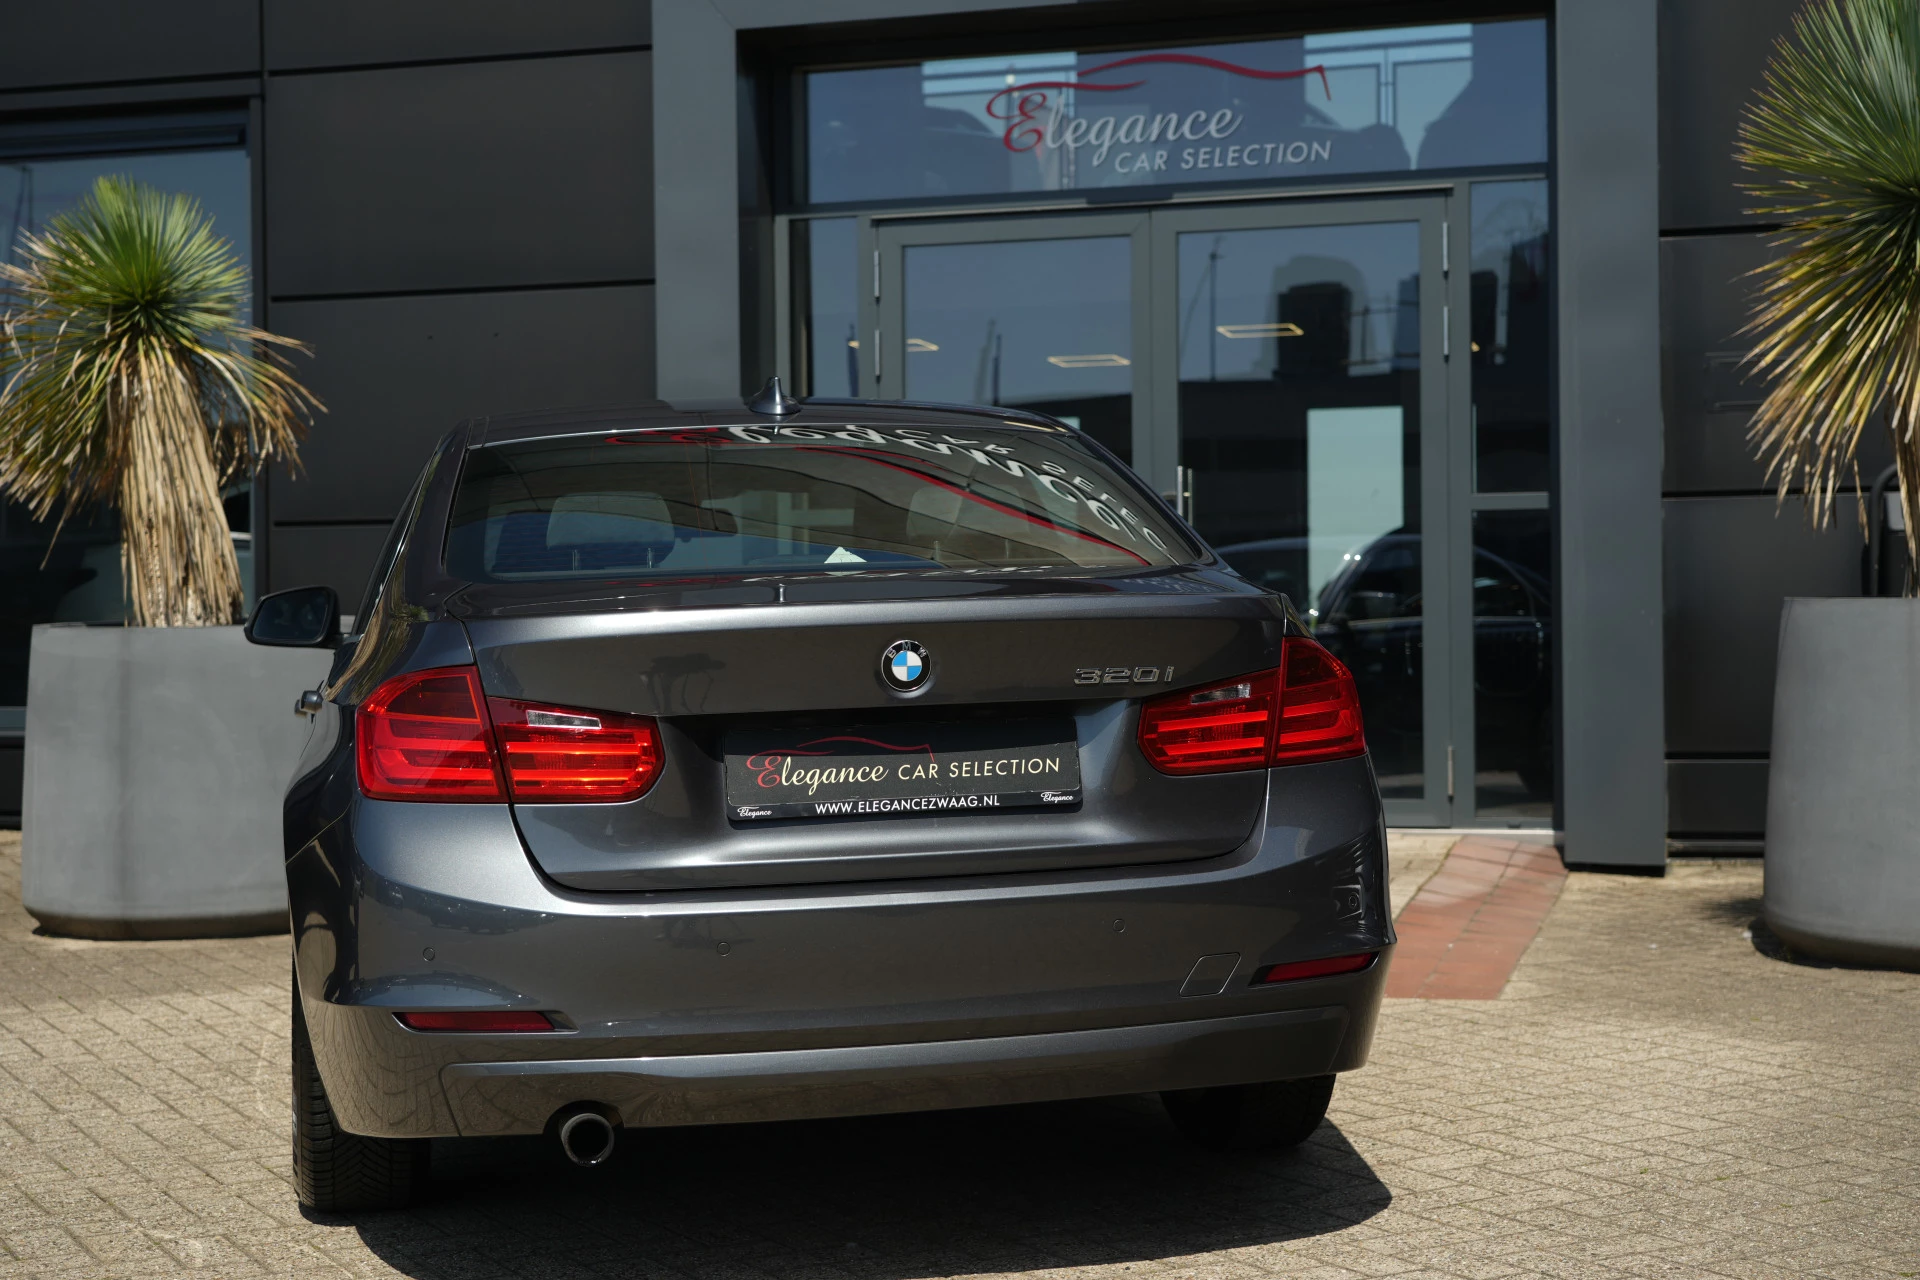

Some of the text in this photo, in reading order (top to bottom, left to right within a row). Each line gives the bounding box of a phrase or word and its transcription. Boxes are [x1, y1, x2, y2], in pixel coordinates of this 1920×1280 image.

[986, 80, 1244, 168] Elegance
[1114, 140, 1332, 175] CAR SELECTION
[886, 641, 927, 659] BMW
[746, 750, 1061, 796] Elegance CAR SELECTION
[814, 794, 1001, 816] WWW.ELEGANCEZWAAG.NL
[1040, 791, 1074, 804] Elegance
[737, 806, 773, 819] Elegance
